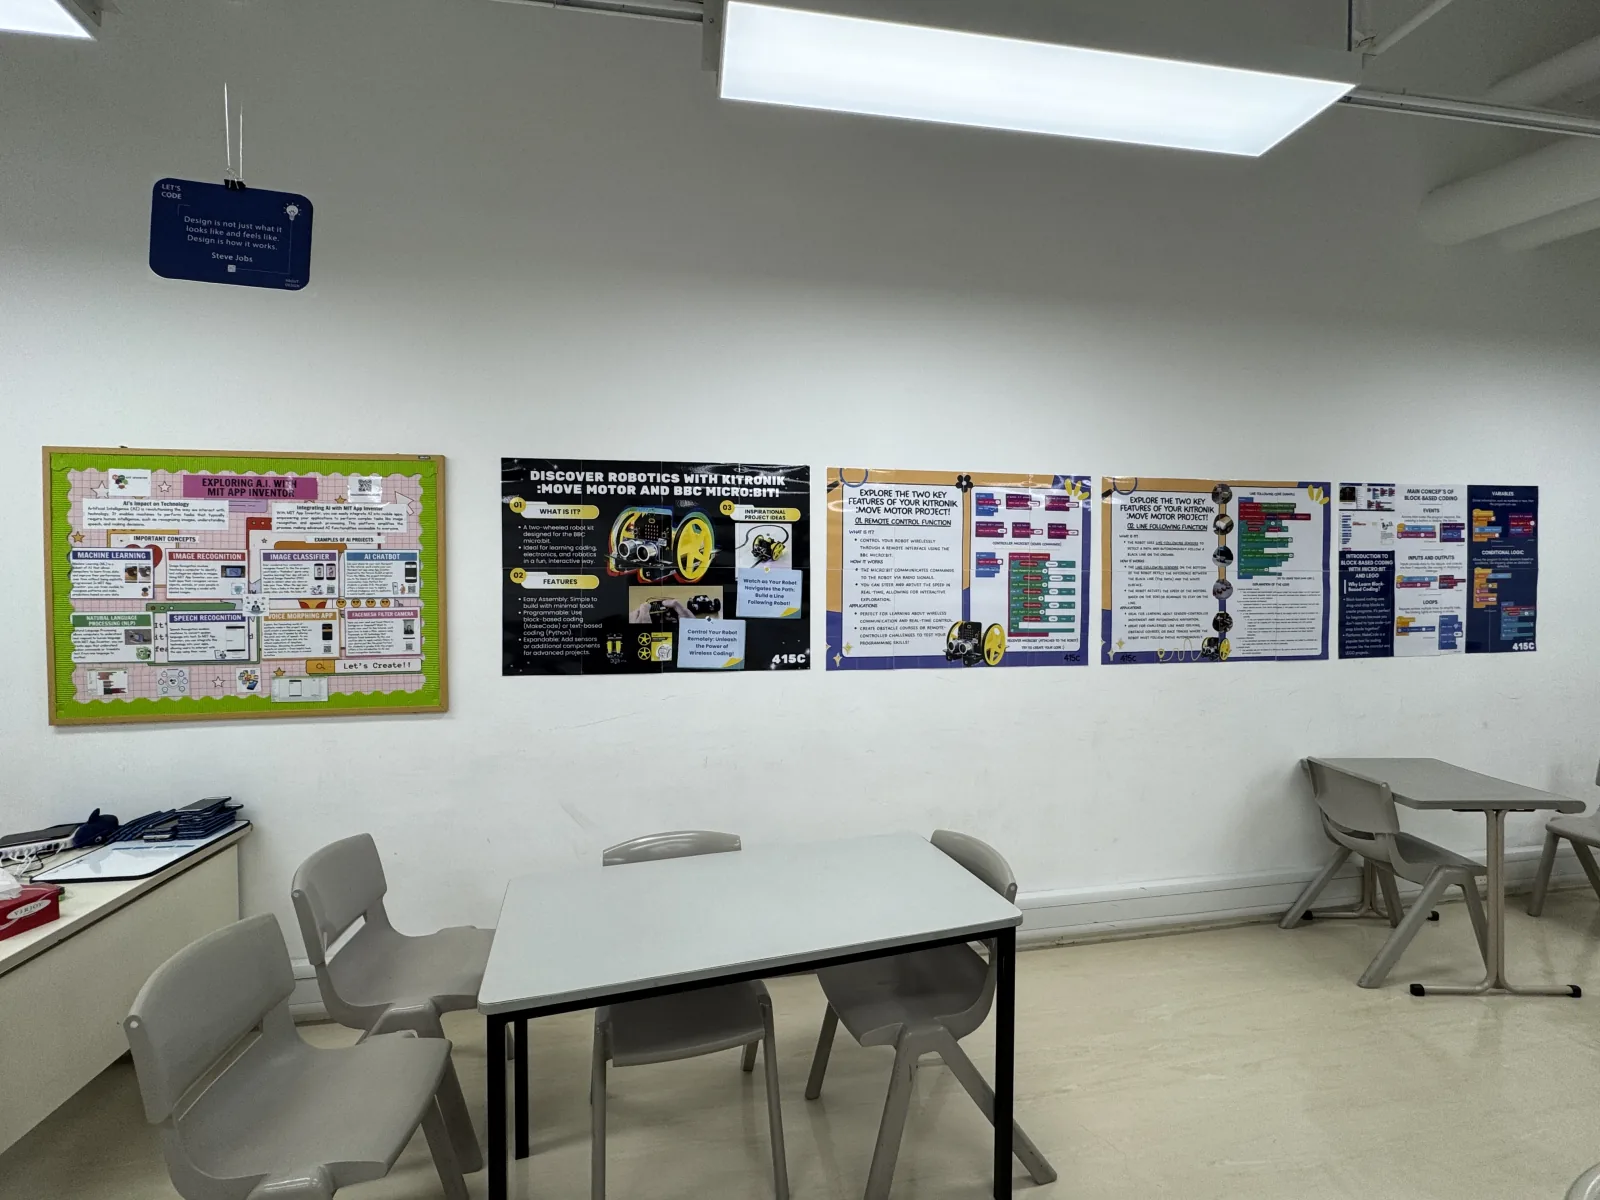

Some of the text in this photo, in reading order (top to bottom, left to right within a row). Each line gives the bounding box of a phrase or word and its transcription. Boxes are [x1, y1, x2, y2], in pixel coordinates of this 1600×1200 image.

[184, 216, 212, 226] Design
[255, 223, 274, 232] what
[187, 234, 215, 244] Design
[243, 231, 261, 239] feels
[263, 233, 279, 241] like.
[212, 252, 233, 260] Steve
[202, 478, 296, 488] EXPLORING A.I. WITH
[530, 470, 786, 486] DISCOVER ROBOTICS WITH KITRONIK
[207, 488, 294, 497] MIT APP INVENTOR
[537, 484, 779, 497] :MOVE MOTOR AND BBC MICRO:BIT!
[772, 654, 806, 663] 415C
